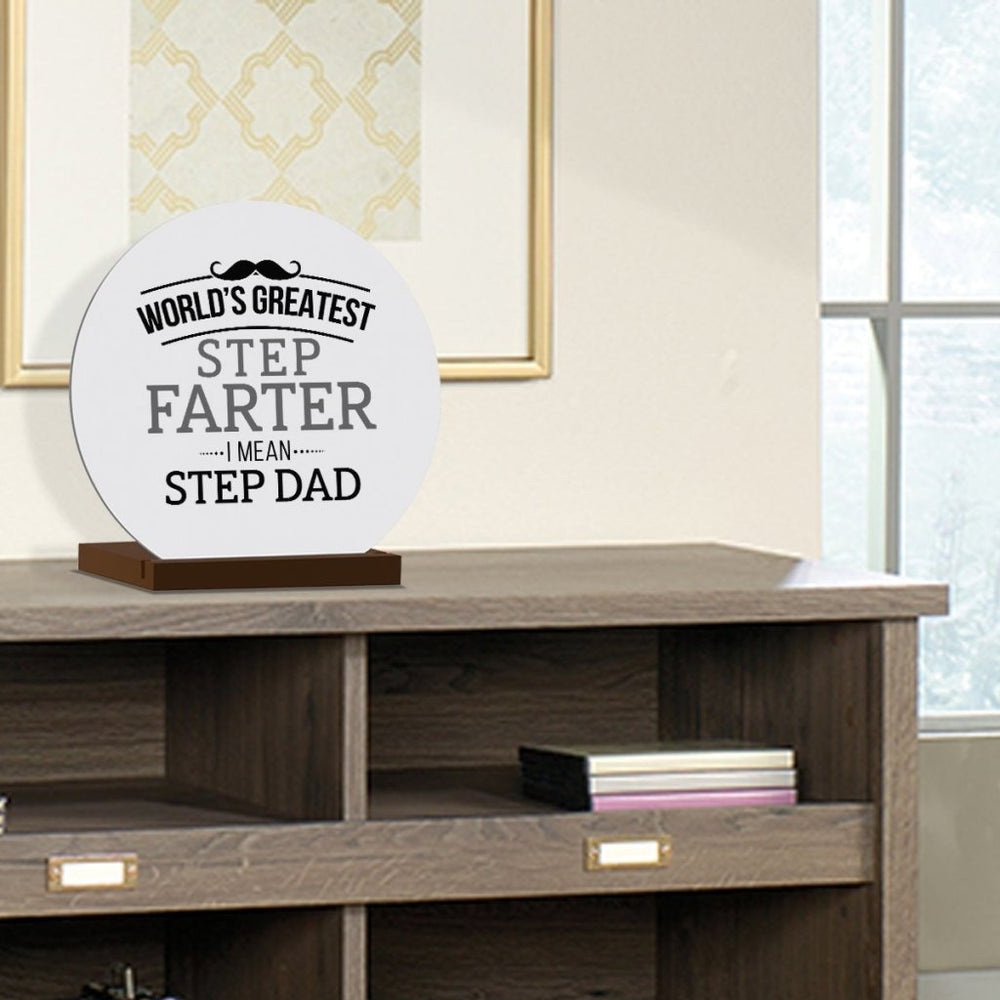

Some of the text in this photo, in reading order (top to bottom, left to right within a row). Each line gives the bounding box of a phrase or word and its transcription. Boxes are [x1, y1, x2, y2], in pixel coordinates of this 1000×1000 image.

[136, 284, 376, 334] WORLD’S GREATEST
[197, 337, 321, 378] STEP
[146, 381, 378, 434] FARTER
[226, 439, 291, 462] I MEAN
[165, 467, 361, 505] STEP DAD
